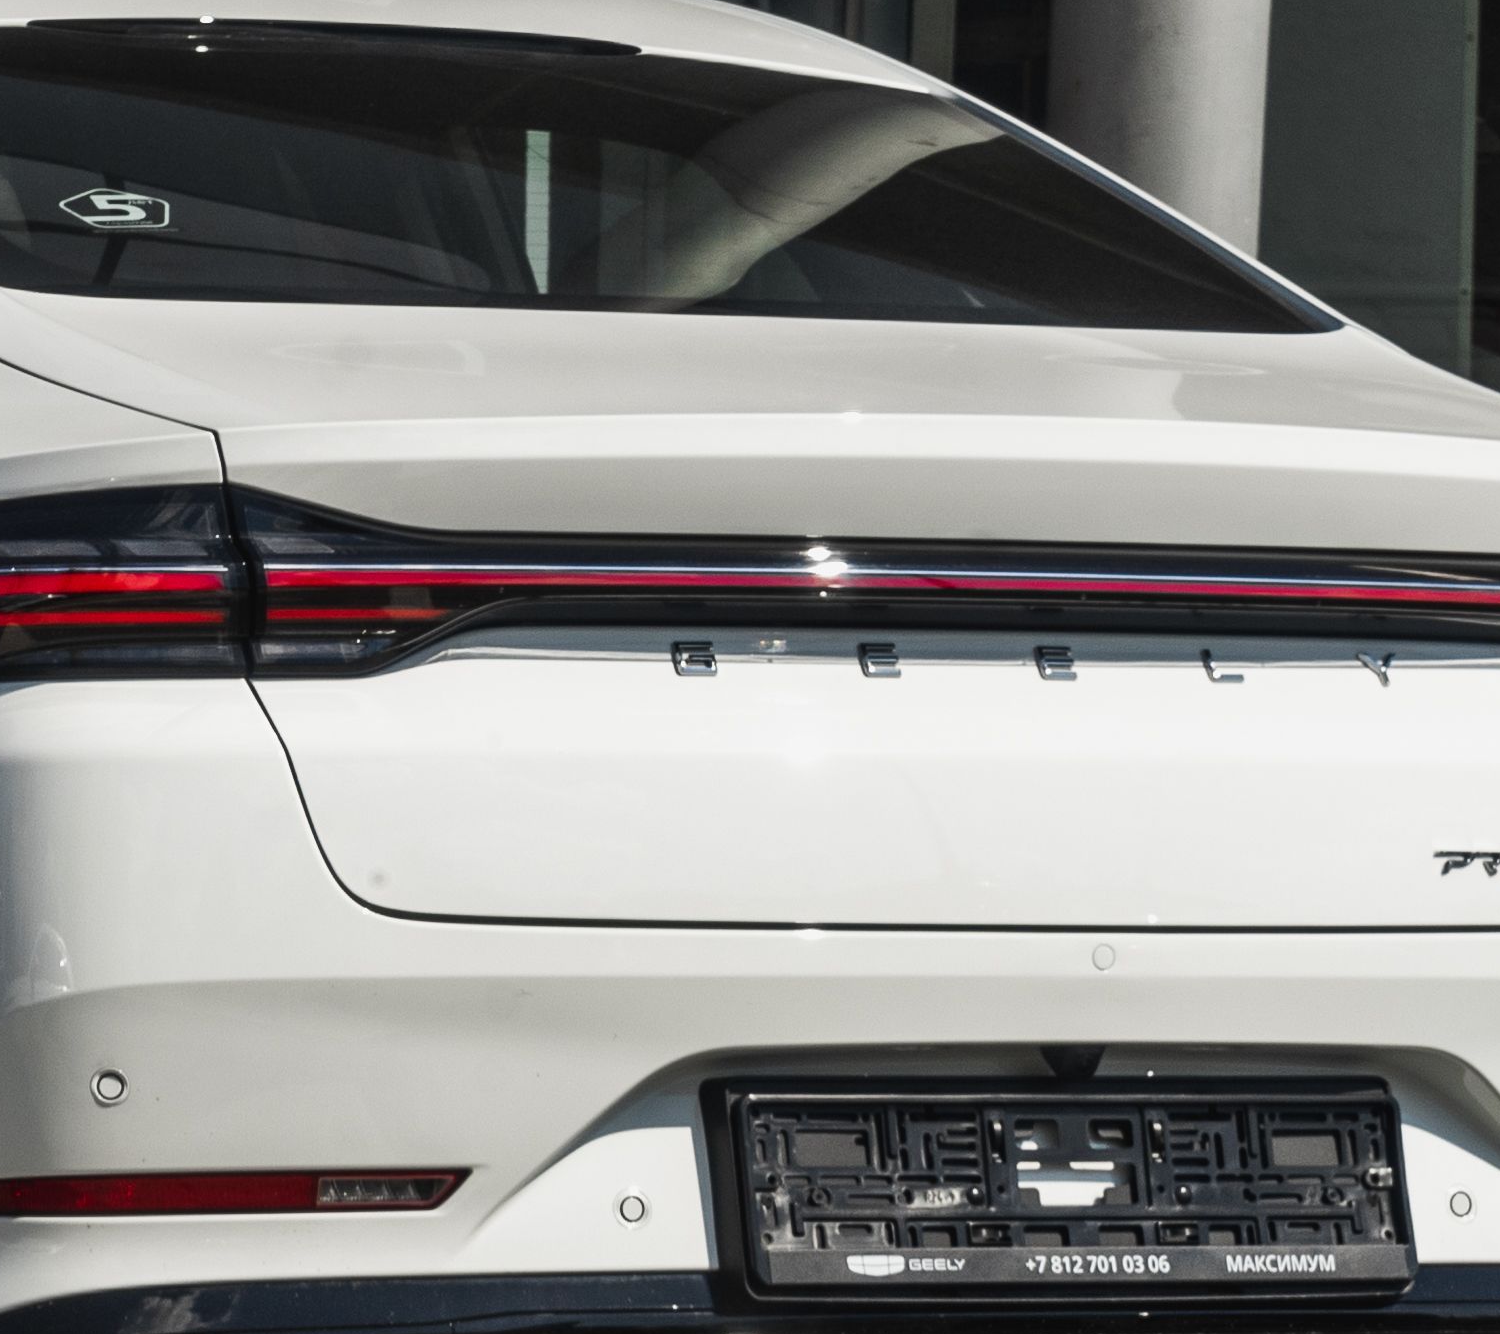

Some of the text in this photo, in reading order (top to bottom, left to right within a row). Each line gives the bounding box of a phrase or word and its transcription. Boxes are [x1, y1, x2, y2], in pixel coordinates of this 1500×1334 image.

[671, 640, 1397, 687] GEELY
[908, 1257, 966, 1271] GEELY
[1025, 1254, 1172, 1274] +7 812 701 03 06
[1226, 1254, 1336, 1273] МАКСИМУМ
